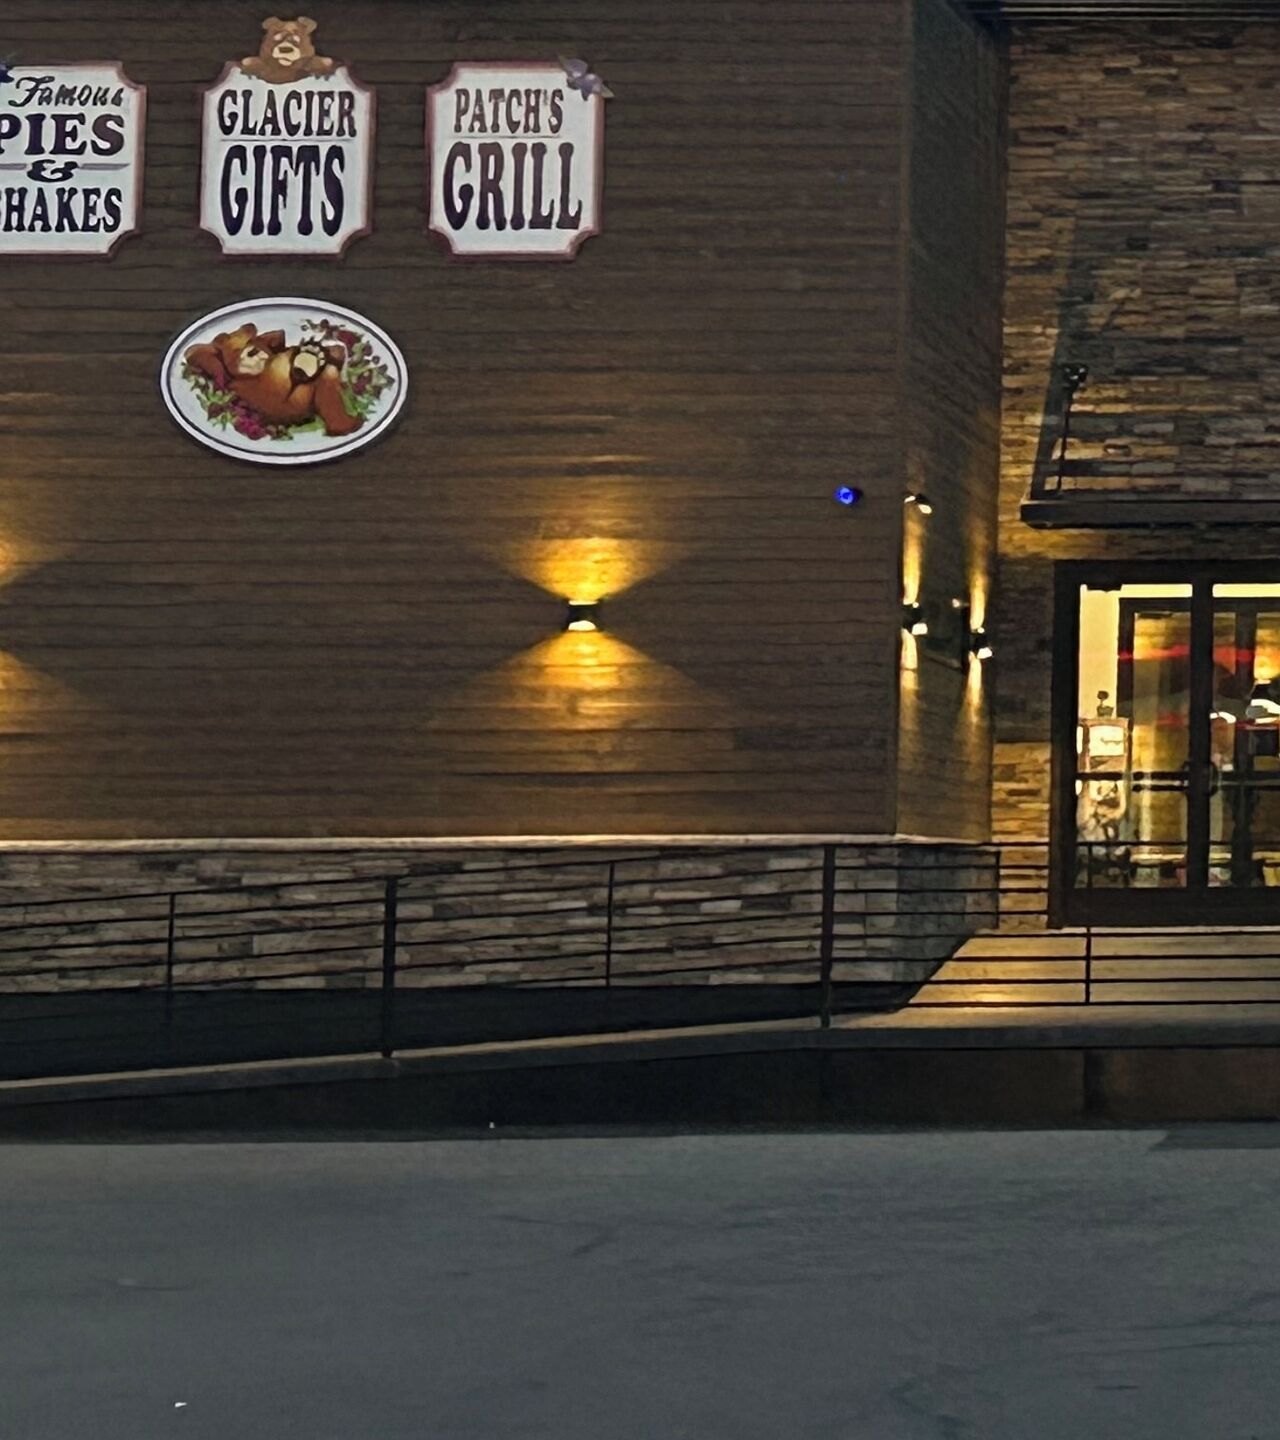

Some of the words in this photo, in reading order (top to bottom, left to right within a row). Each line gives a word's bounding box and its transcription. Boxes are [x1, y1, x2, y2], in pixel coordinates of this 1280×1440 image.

[8, 75, 124, 108] Famous
[217, 88, 358, 137] GLACIER
[453, 87, 565, 135] PATCH'S
[0, 112, 126, 157] PIES
[26, 158, 80, 184] &
[220, 144, 345, 237] GIFTS
[442, 141, 583, 232] GRILL
[0, 185, 123, 234] HAKES
